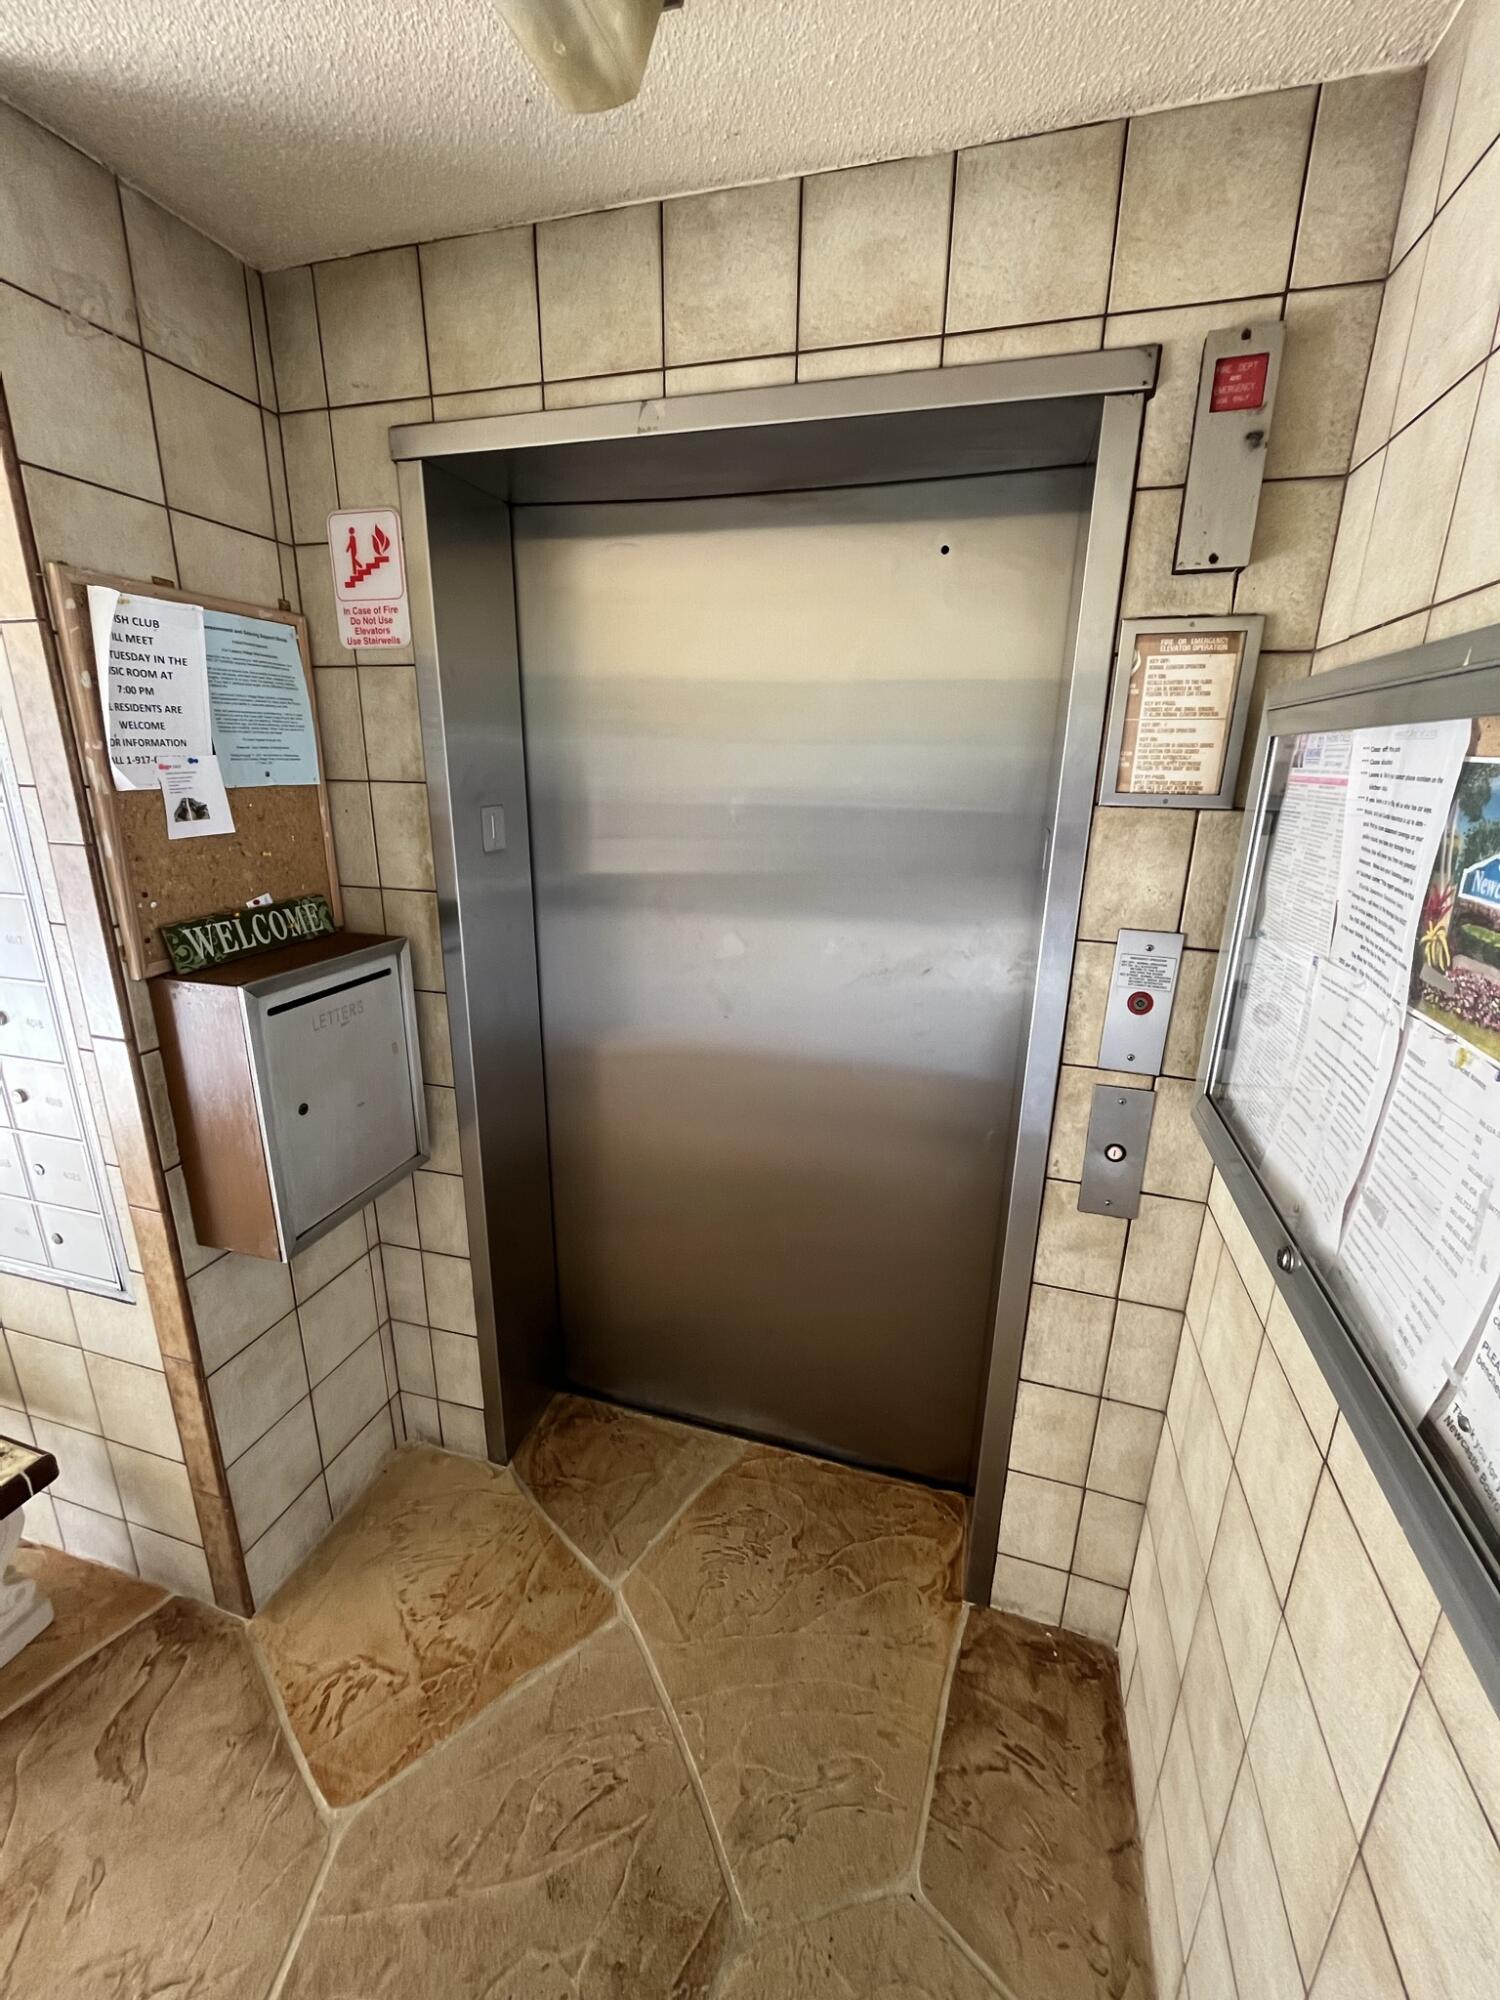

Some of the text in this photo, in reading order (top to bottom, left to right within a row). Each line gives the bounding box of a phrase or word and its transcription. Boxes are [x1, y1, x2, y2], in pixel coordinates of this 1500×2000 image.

[343, 605, 399, 615] In Case of Fire
[132, 617, 160, 629] CLUB
[350, 616, 393, 625] Do Not Use
[354, 626, 391, 635] Elevators
[125, 634, 154, 645] MEET
[347, 636, 401, 646] Use Stairwells
[109, 650, 188, 666] TUESDAY IN THE
[126, 667, 158, 679] ROOM
[160, 671, 174, 680] AT
[117, 685, 155, 695] 7:00 PM
[114, 703, 163, 713] RESIDENTS
[164, 705, 183, 714] ARE
[119, 721, 166, 730] WELCOME
[122, 739, 187, 747] INFORMATION
[179, 903, 325, 960] WELCOME
[312, 1000, 364, 1031] LETTERS
[1443, 1415, 1480, 1474] Newcastle
[1487, 1461, 1498, 1480] for
